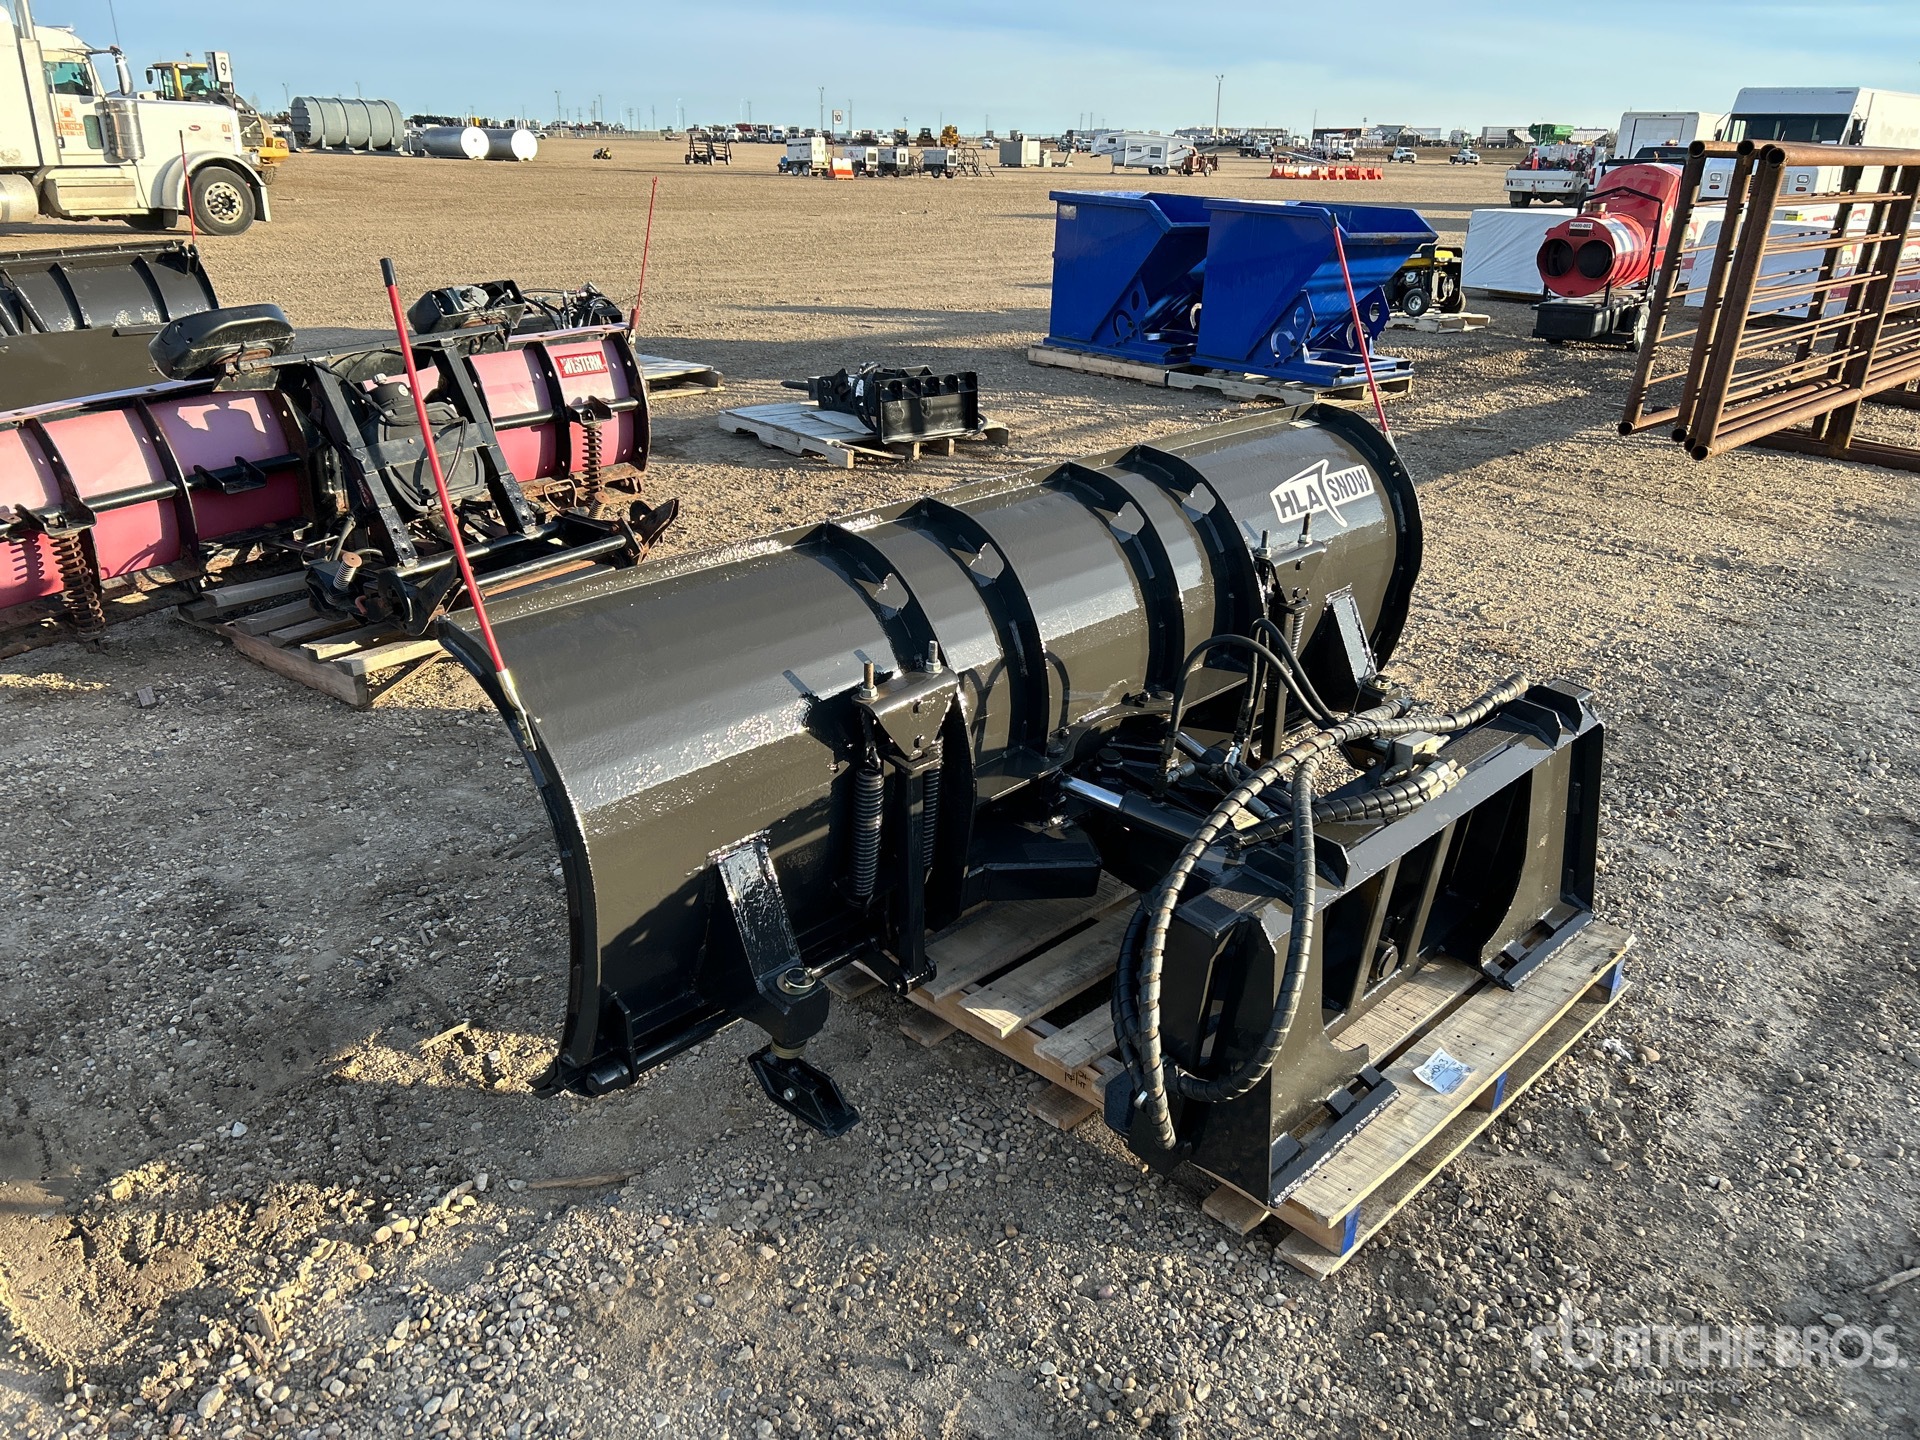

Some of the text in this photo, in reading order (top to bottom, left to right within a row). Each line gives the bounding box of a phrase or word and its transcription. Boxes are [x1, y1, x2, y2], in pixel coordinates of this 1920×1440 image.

[220, 61, 227, 76] 9
[834, 114, 842, 122] 10
[561, 353, 604, 374] WESTERN
[1275, 468, 1371, 518] HLA SNOW
